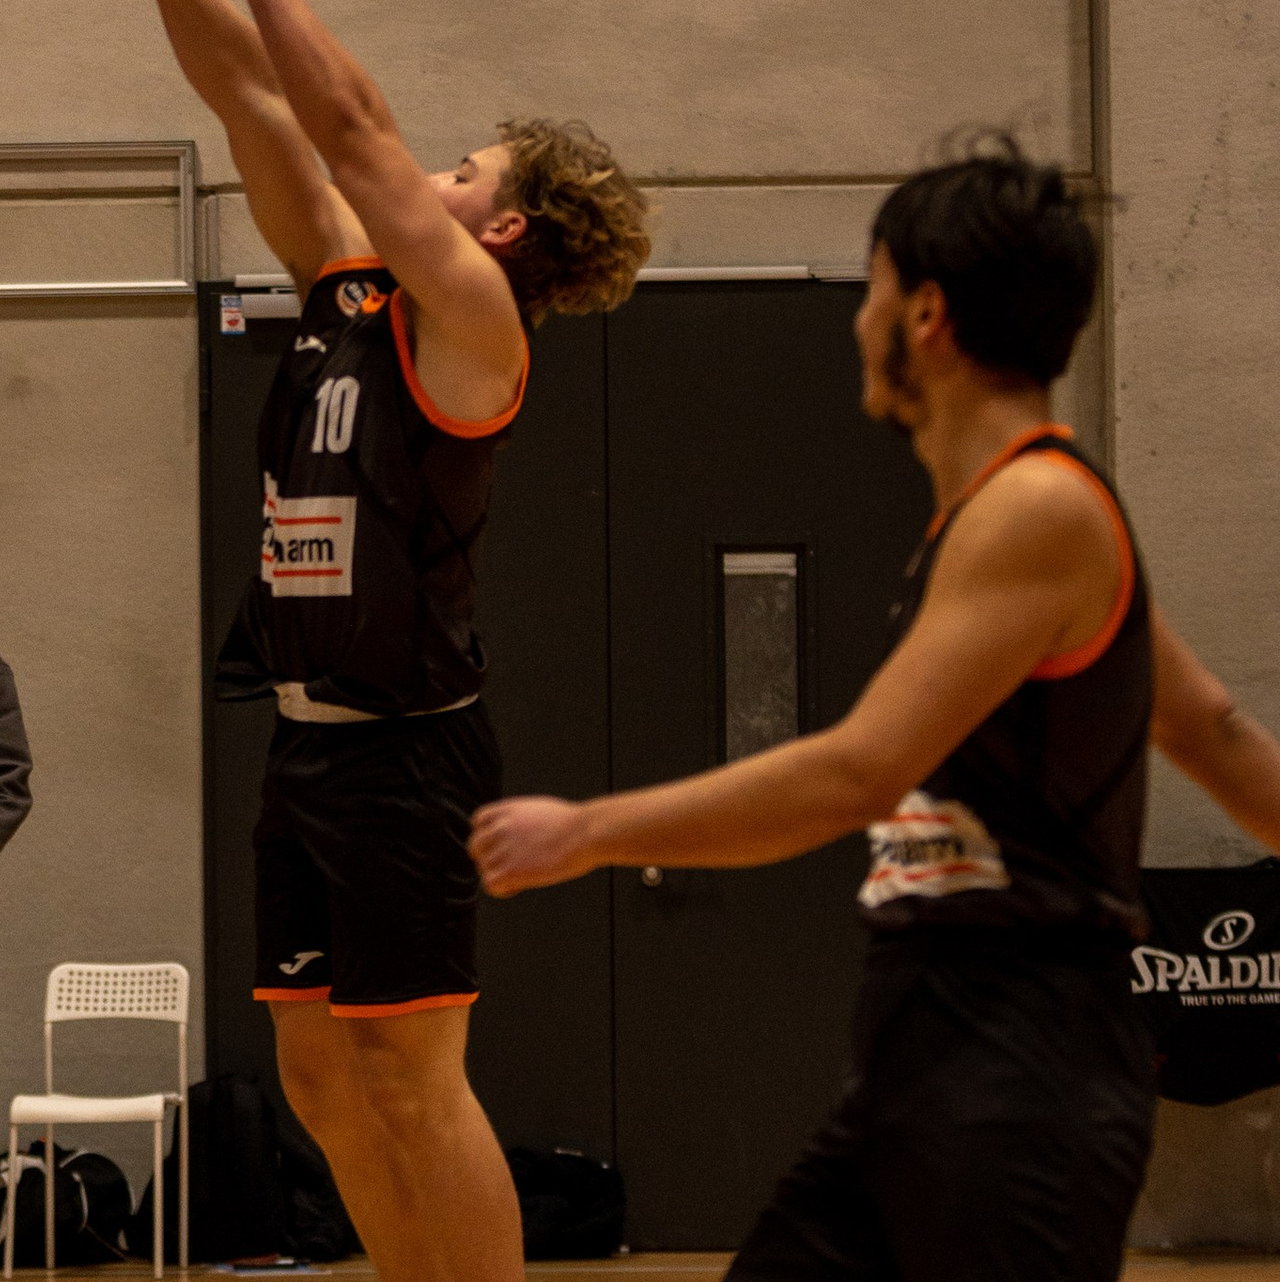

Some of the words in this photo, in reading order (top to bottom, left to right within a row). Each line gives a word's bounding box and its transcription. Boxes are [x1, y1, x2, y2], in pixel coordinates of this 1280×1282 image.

[311, 375, 360, 453] 10
[1180, 995, 1209, 1006] TRUE
[1211, 996, 1225, 1005] TO
[1226, 994, 1247, 1005] THE
[1249, 993, 1280, 1004] GAME
